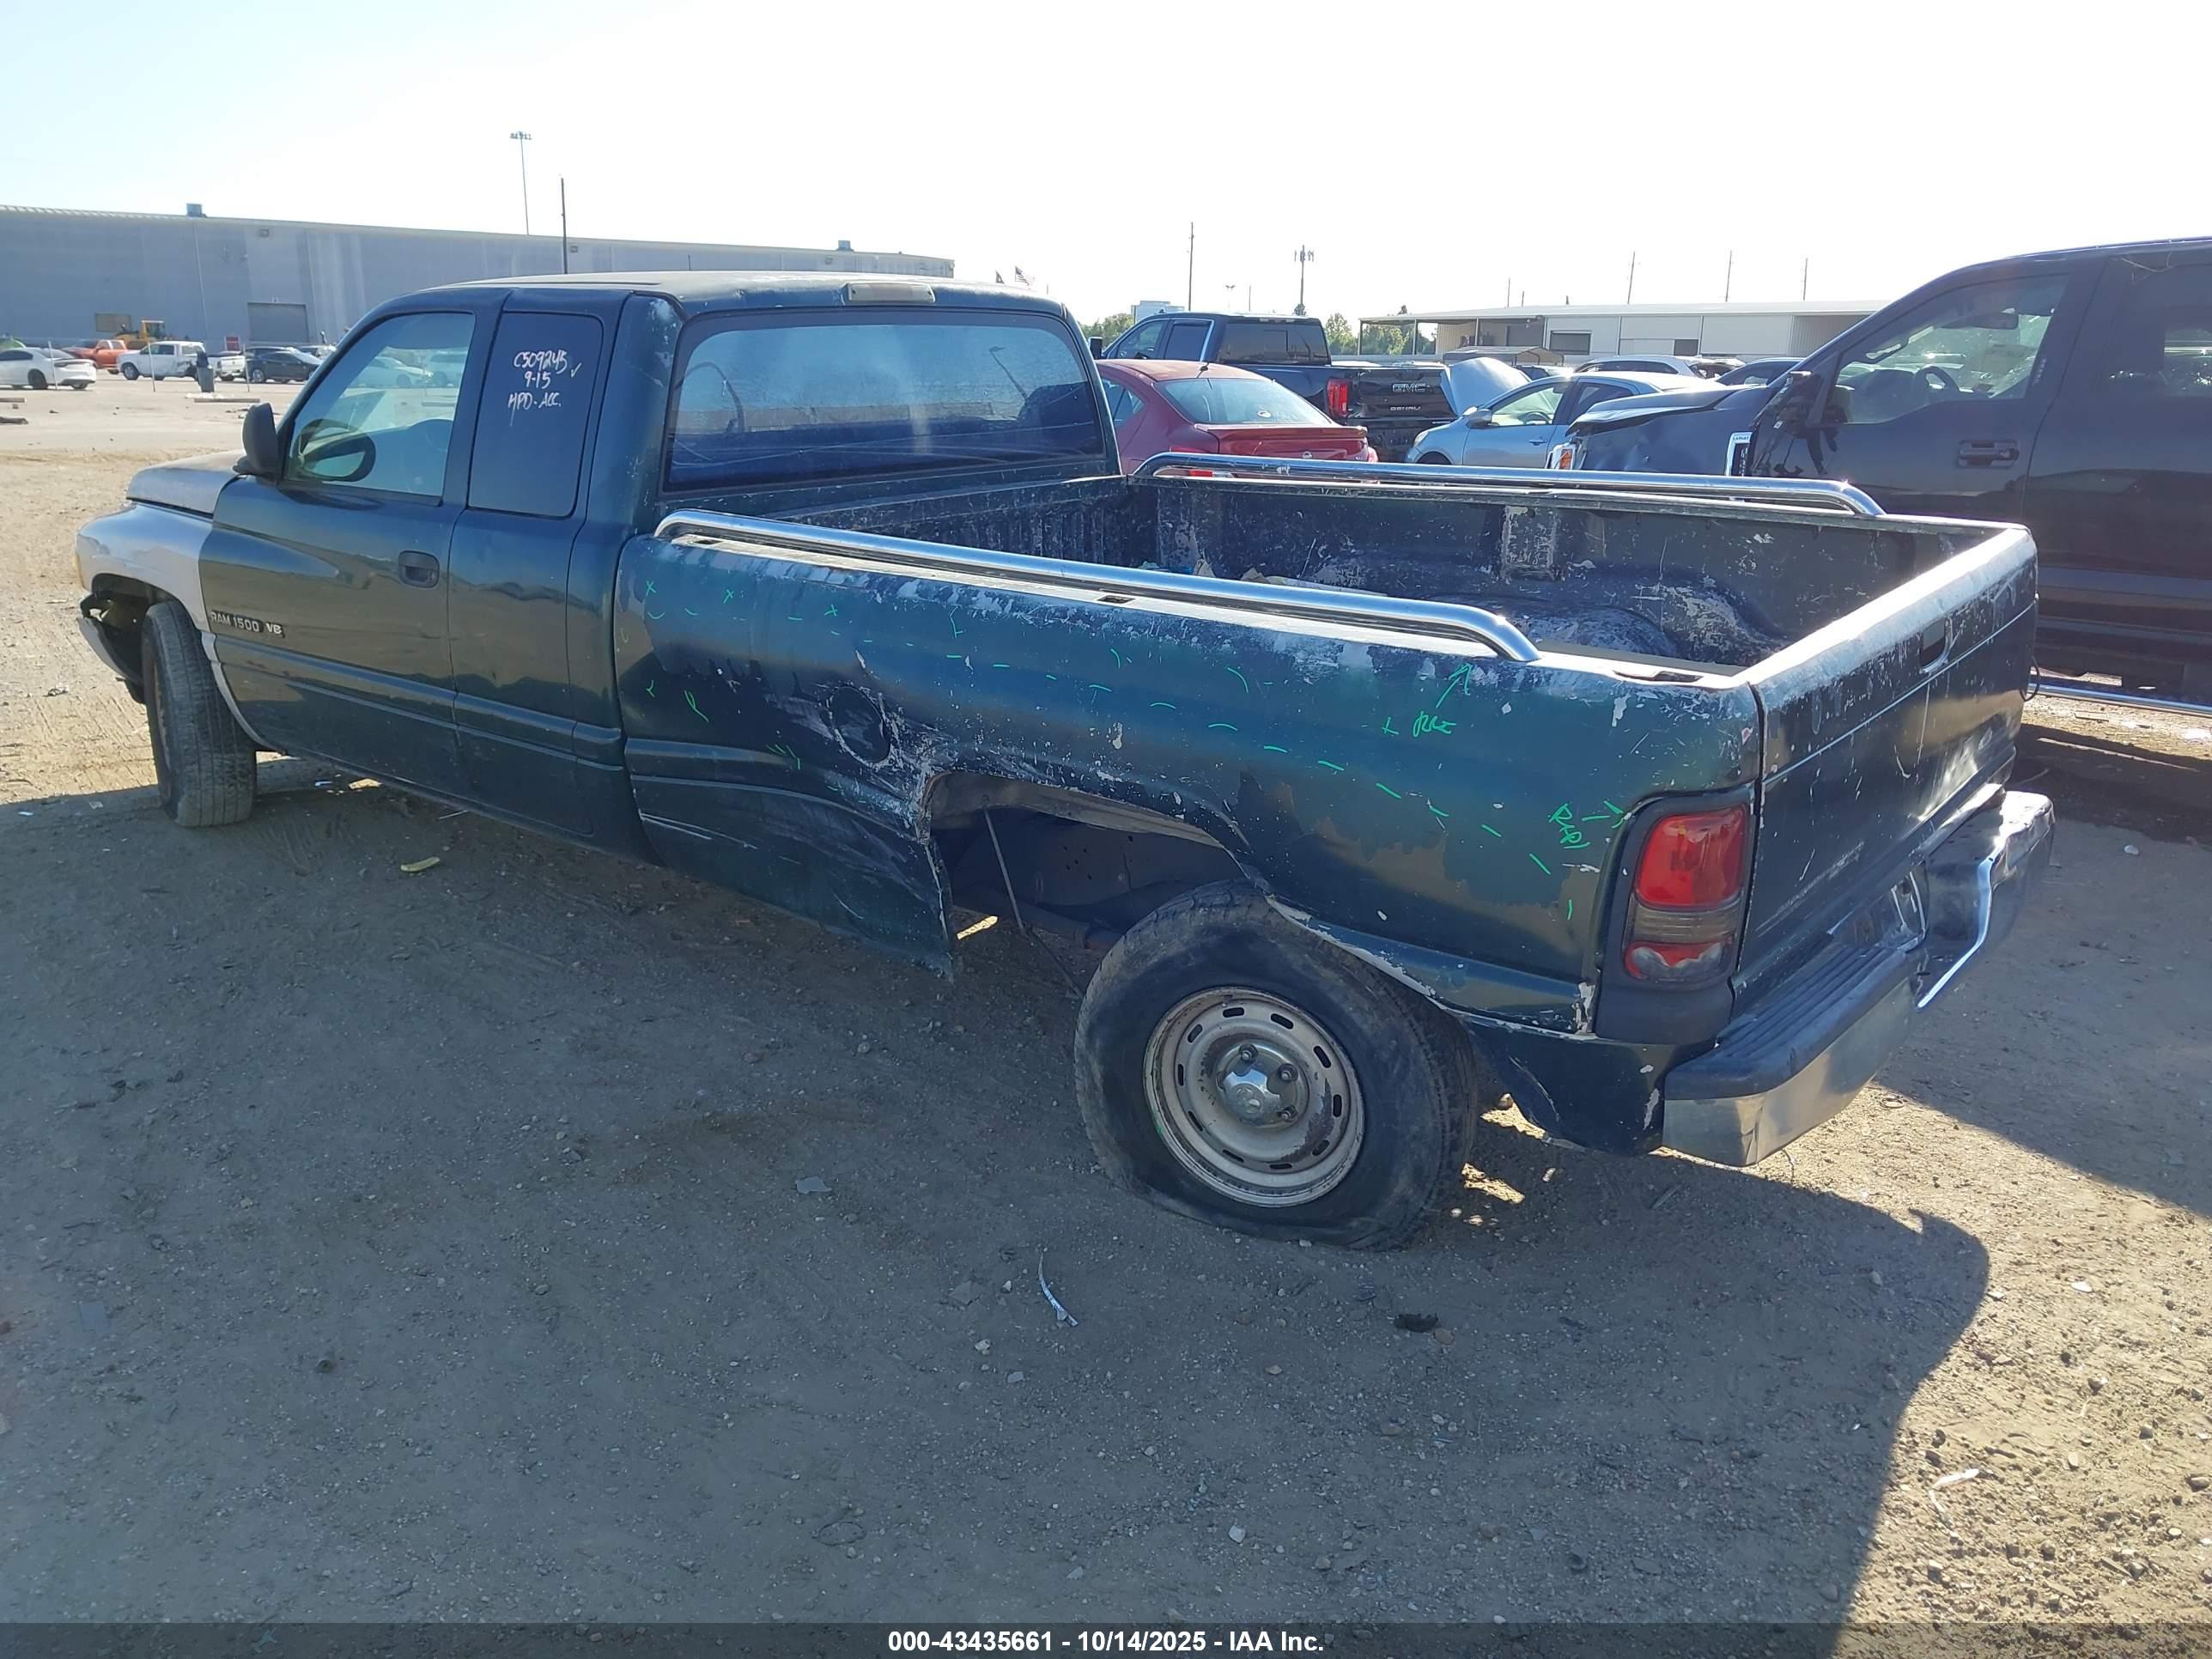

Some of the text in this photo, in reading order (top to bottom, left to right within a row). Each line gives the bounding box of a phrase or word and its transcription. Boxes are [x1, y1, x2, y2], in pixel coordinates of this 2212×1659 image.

[524, 370, 551, 389] 9-15
[1392, 383, 1425, 392] GMC
[210, 611, 232, 626] RAM
[234, 617, 259, 633] 1500
